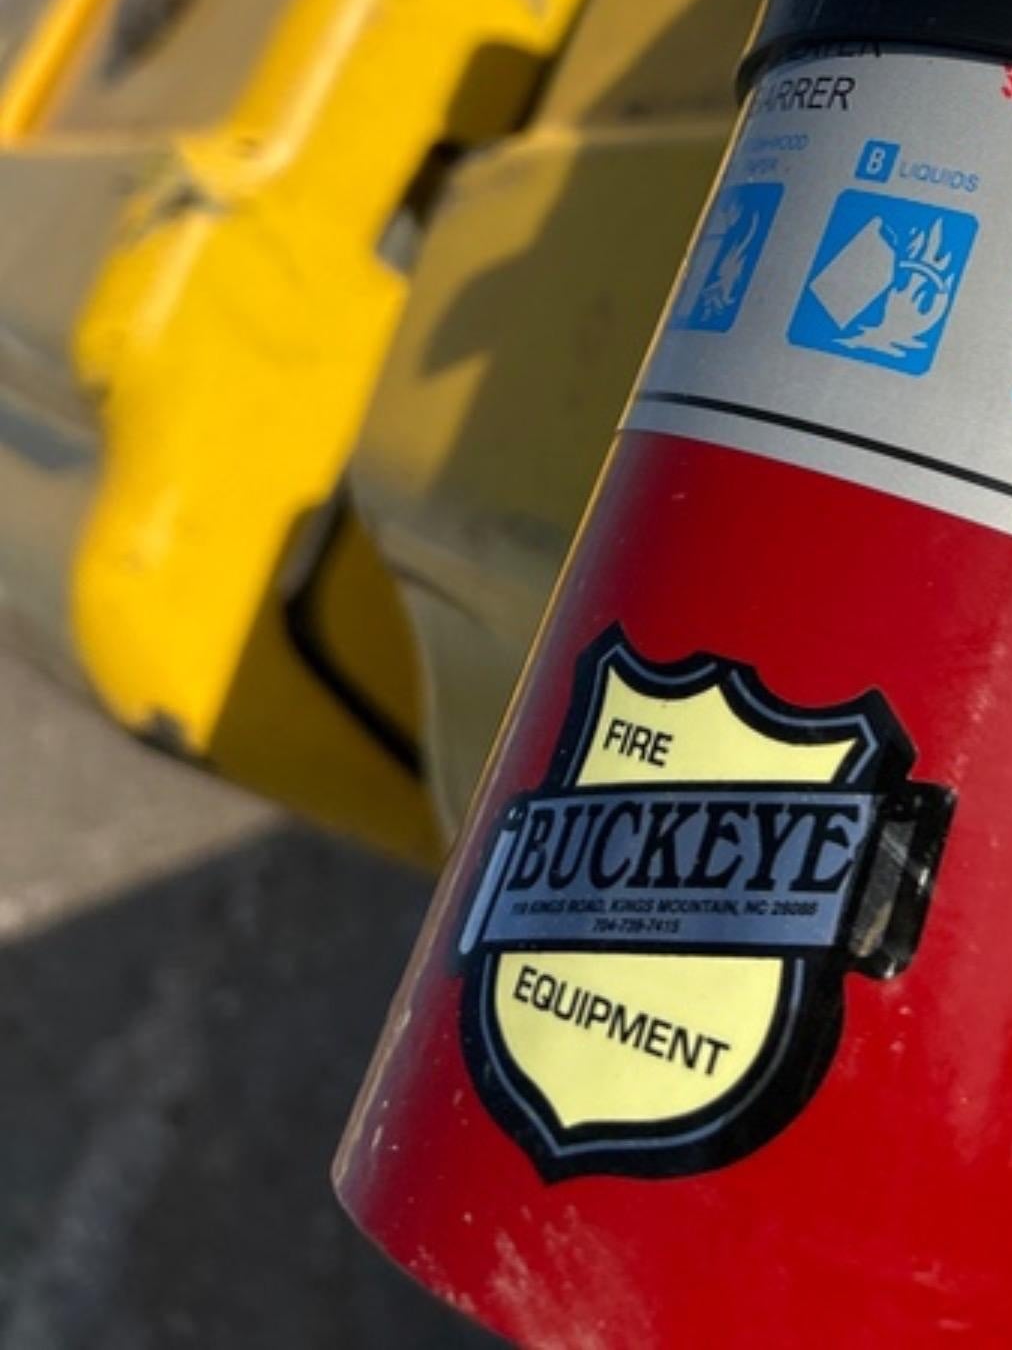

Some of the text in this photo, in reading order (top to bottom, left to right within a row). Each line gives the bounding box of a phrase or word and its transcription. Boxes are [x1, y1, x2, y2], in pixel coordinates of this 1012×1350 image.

[865, 147, 980, 193] B LIQUIDS
[603, 718, 673, 768] FIRE
[508, 801, 861, 893] BUCKEYE
[610, 898, 655, 914] KINGS
[656, 898, 738, 916] MOUNTAIN,
[744, 899, 769, 915] NC
[512, 964, 732, 1077] EQUIPMENT
